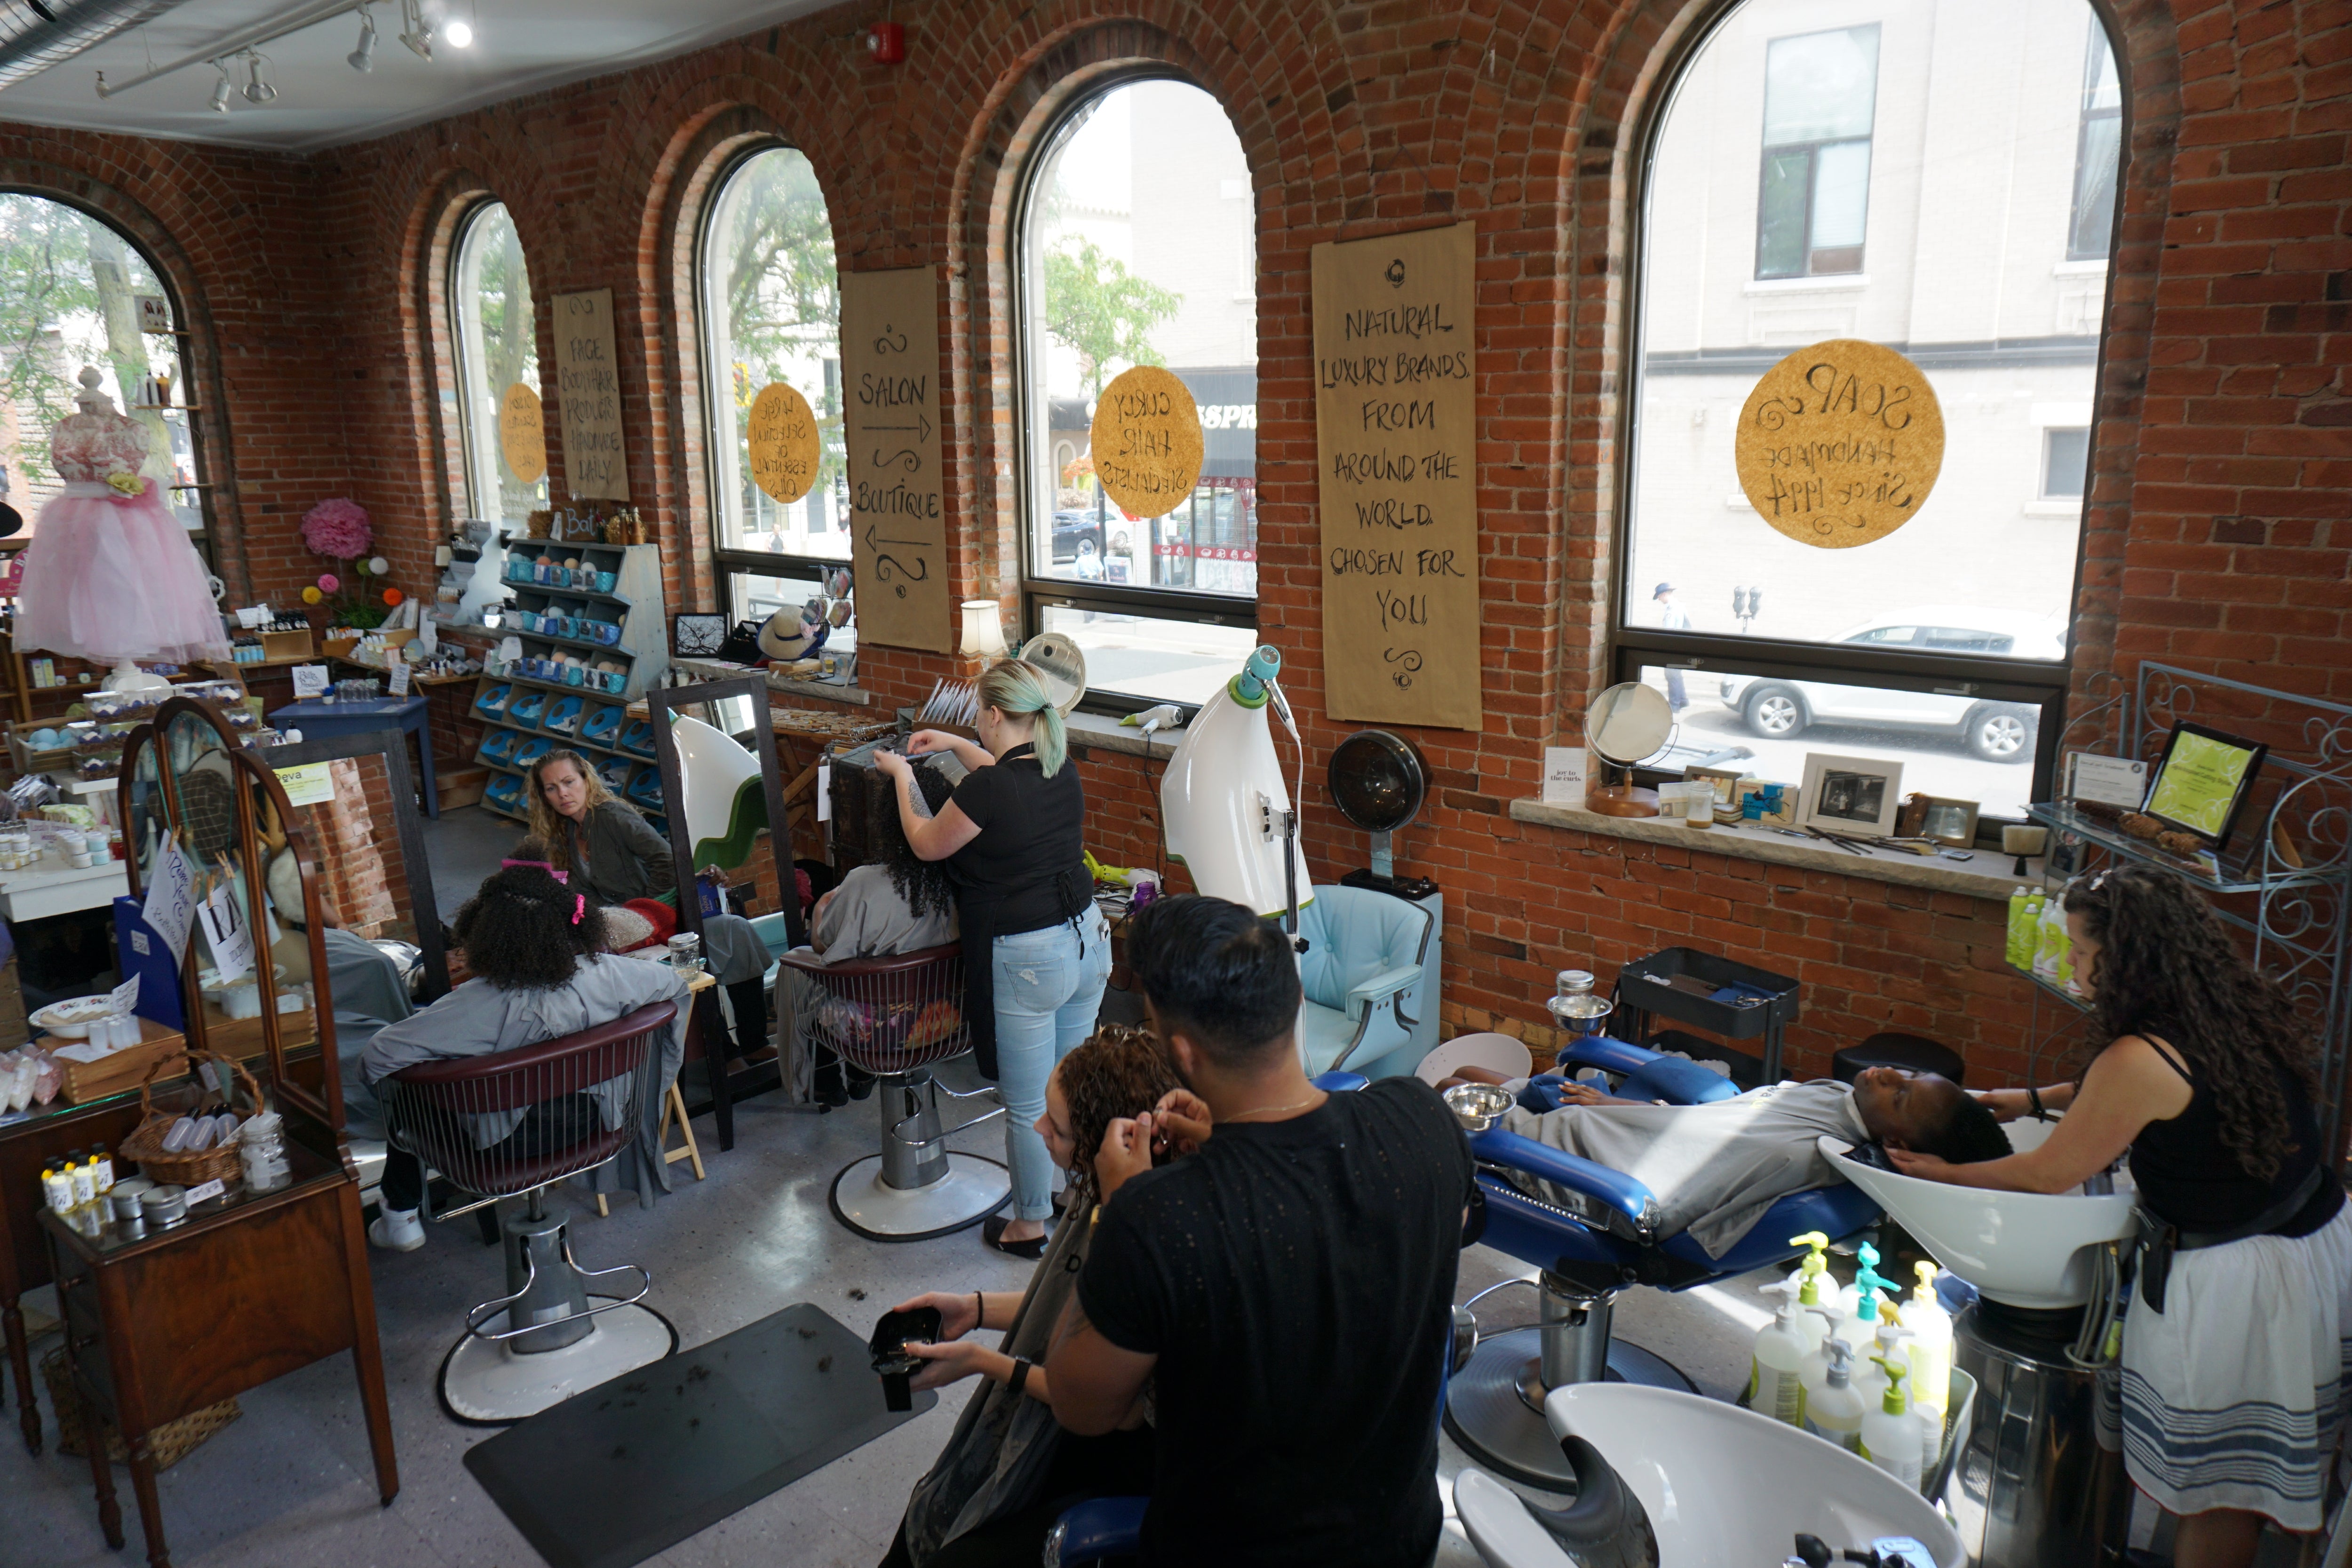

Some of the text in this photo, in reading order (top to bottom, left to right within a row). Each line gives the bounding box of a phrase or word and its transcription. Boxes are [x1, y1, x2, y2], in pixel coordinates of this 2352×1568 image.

[1346, 303, 1454, 340] NATURAL
[1321, 356, 1388, 388] LUXURY
[858, 373, 925, 407] SALON
[565, 396, 614, 424] PRODUCTS
[1362, 399, 1435, 431] FROM
[570, 429, 620, 452] HANDMADE
[579, 455, 611, 485] DAILY
[1334, 448, 1459, 484] AROUND THE
[1330, 548, 1465, 577] CHOSEN FOR
[1376, 589, 1427, 632] YOU
